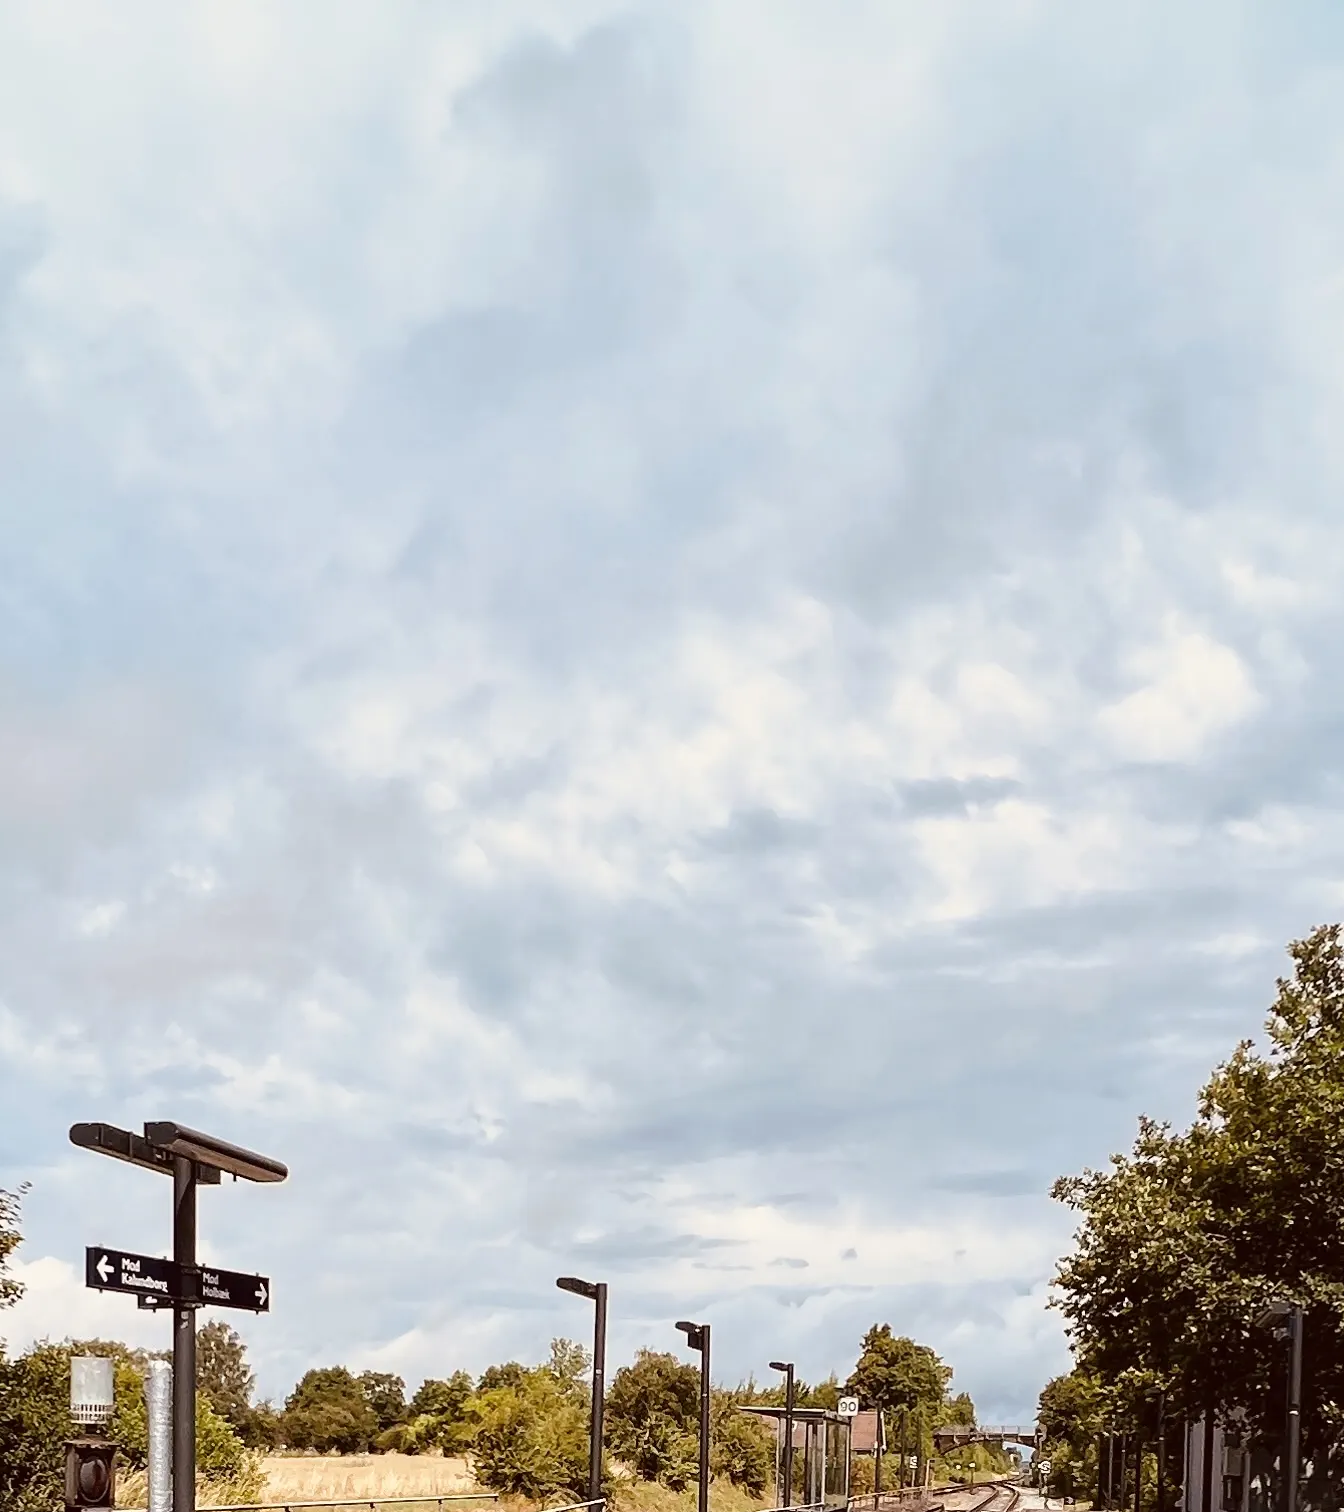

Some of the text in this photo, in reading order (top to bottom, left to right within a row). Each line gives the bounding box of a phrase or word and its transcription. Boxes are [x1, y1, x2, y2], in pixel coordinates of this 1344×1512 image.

[121, 1257, 141, 1273] Mod
[202, 1271, 219, 1285] Mod
[840, 1401, 857, 1412] 90
